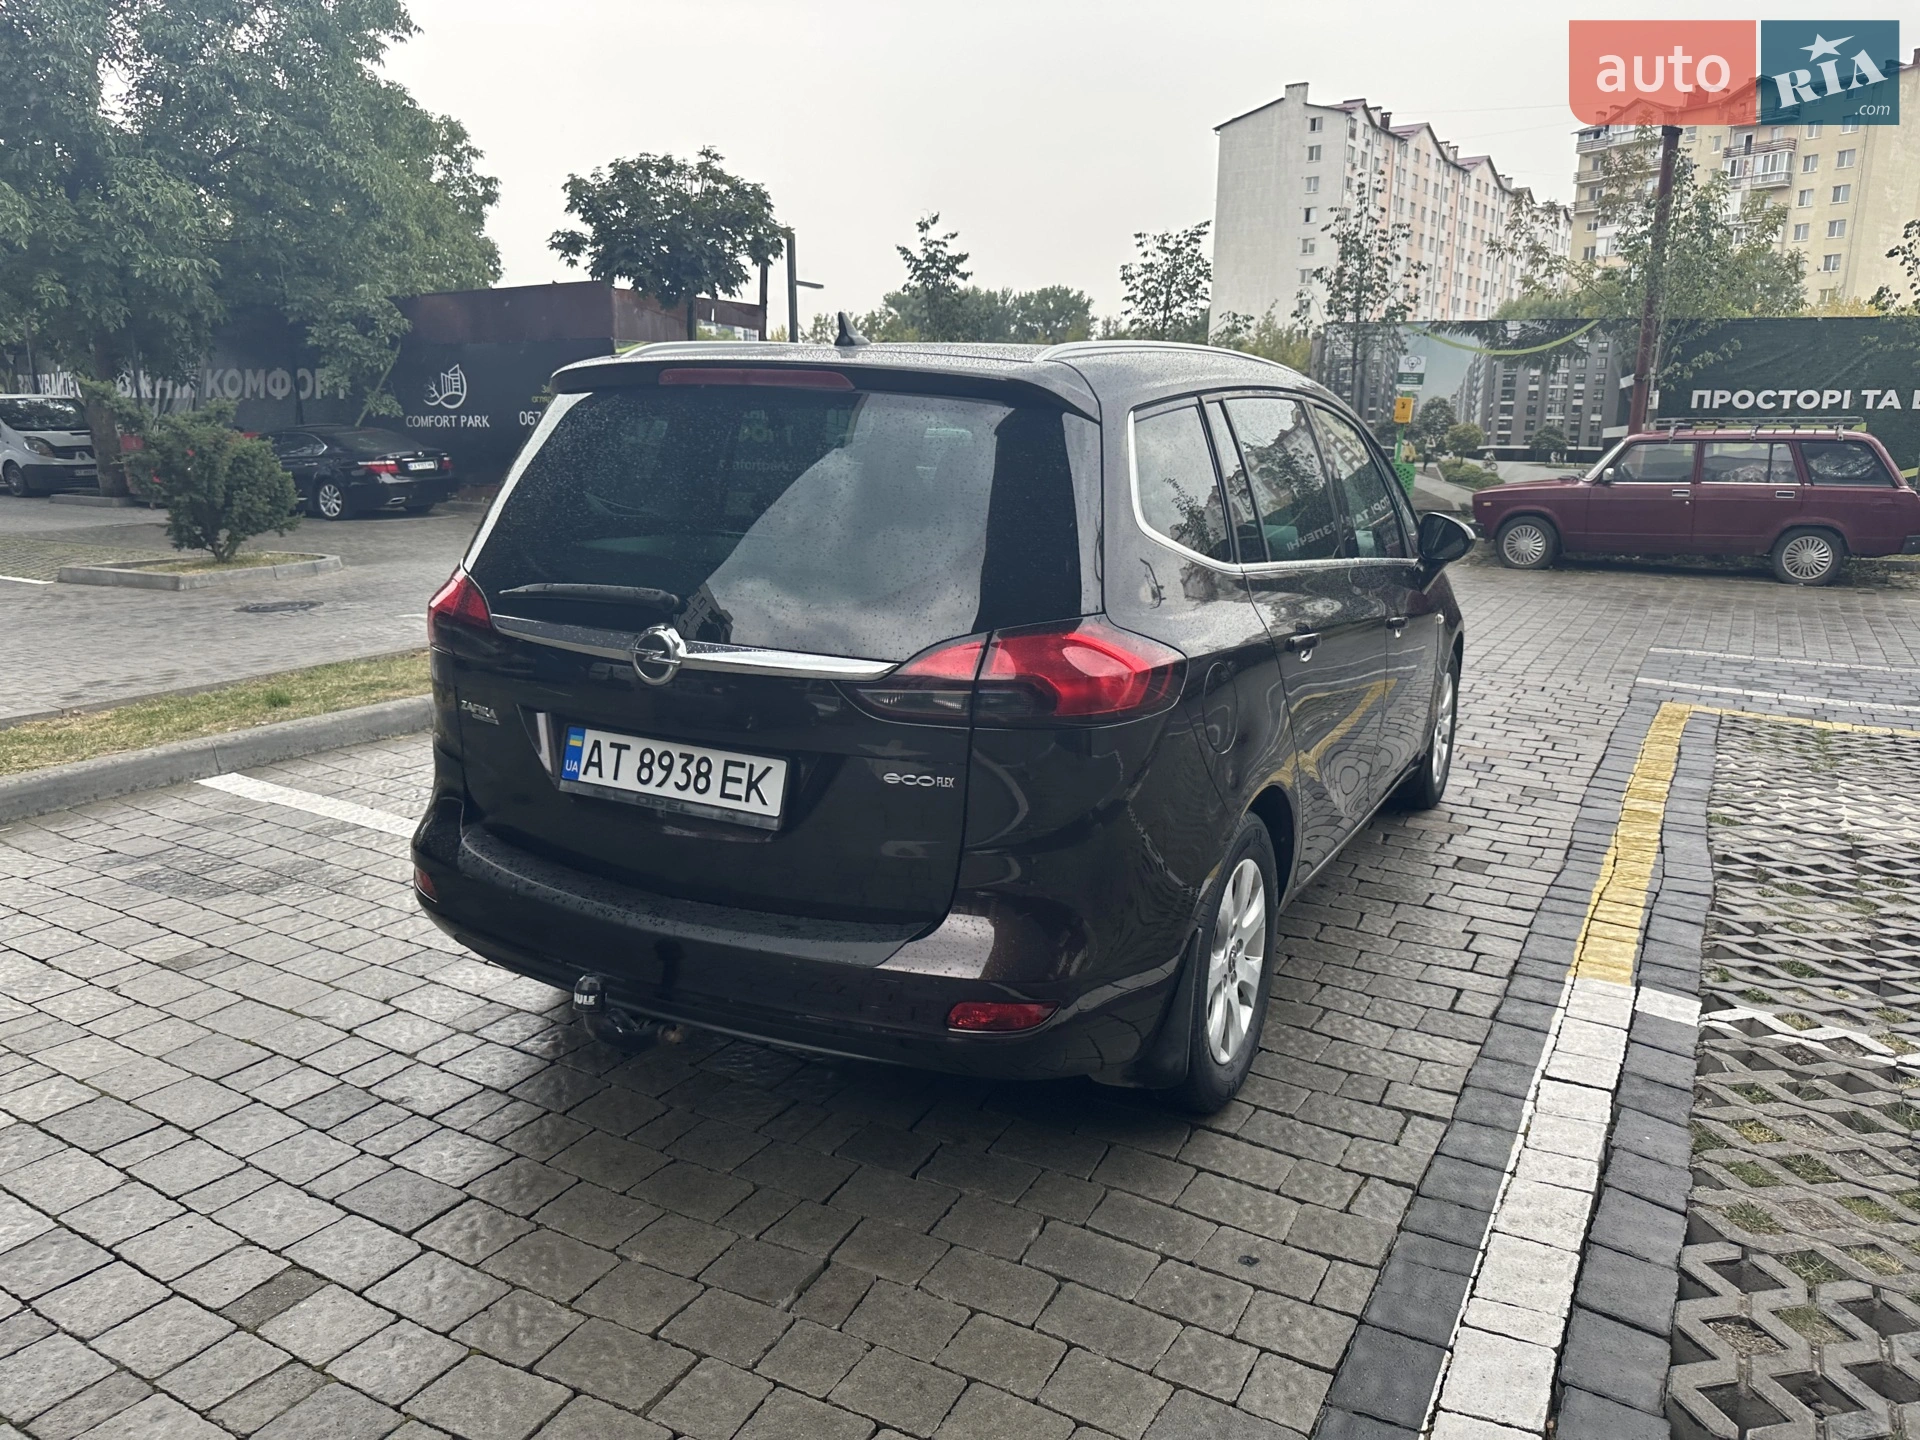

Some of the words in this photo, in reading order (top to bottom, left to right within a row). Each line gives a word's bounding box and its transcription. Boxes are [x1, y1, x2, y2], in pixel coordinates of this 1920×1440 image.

[1690, 390, 1852, 409] ПРОСТОРІ
[1861, 390, 1902, 409] ТА
[406, 415, 457, 428] COMFORT
[460, 415, 490, 428] PARK
[565, 760, 579, 773] UA
[582, 740, 631, 781] AT
[636, 747, 713, 795] 8938
[719, 759, 773, 806] EK
